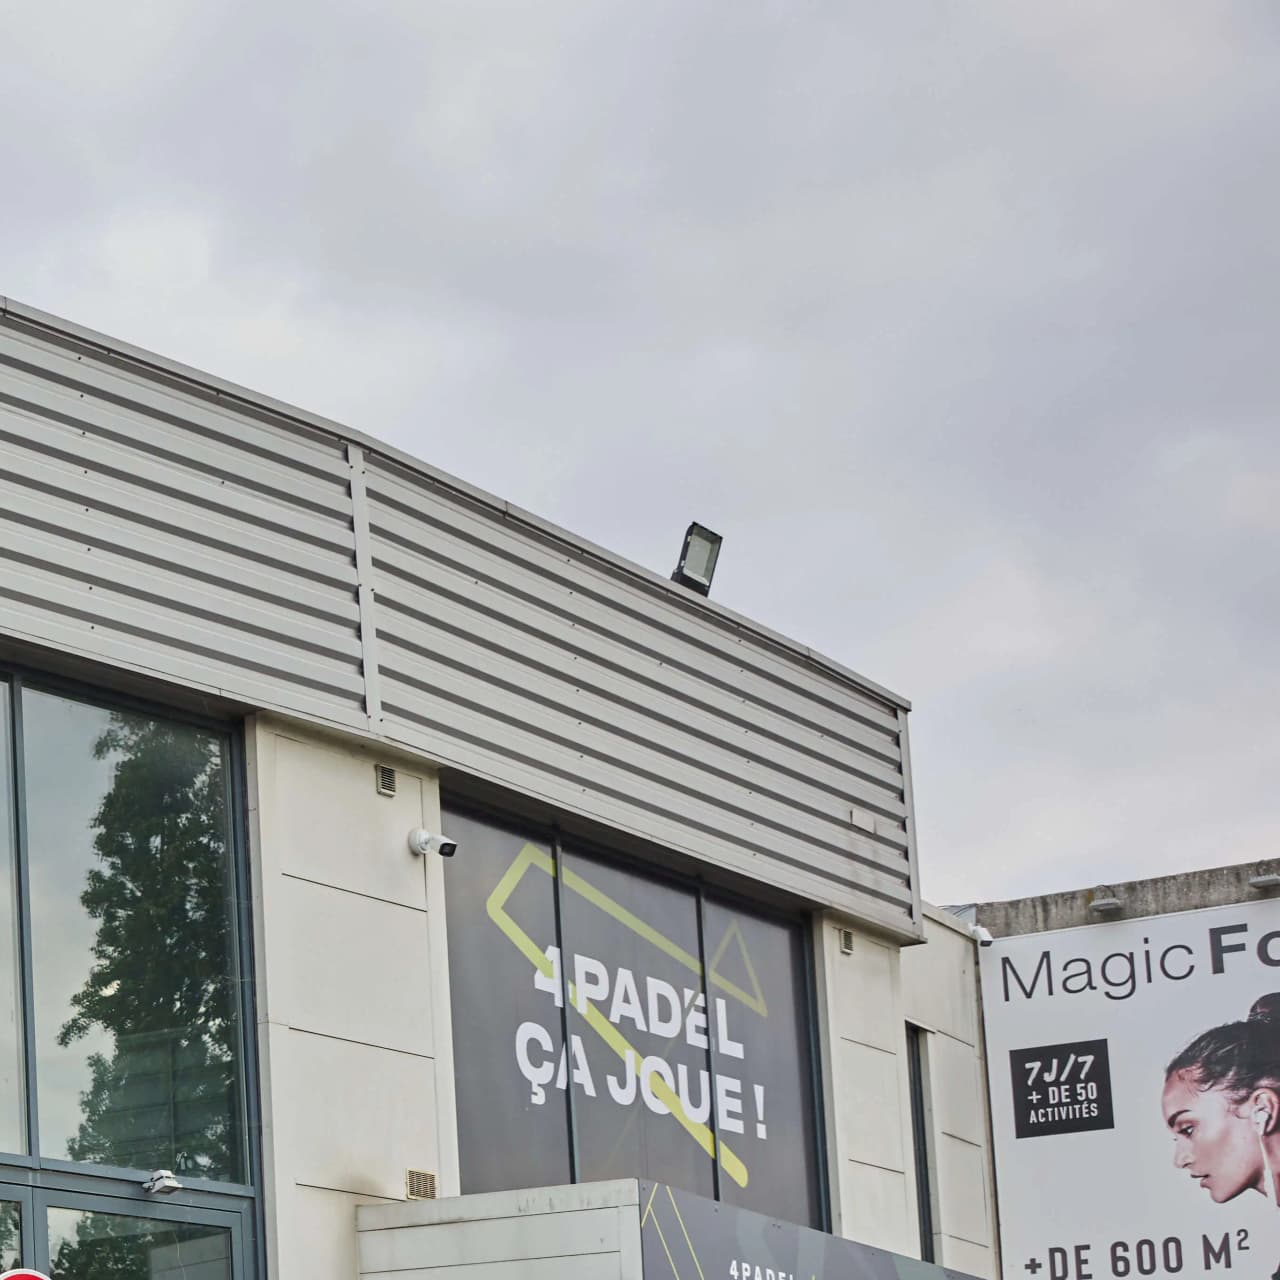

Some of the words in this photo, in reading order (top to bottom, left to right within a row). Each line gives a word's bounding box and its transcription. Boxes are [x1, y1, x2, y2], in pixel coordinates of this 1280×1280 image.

[515, 1021, 596, 1105] ÇA
[1024, 1054, 1095, 1087] 7J/7
[1048, 1085, 1071, 1105] DE
[1076, 1082, 1097, 1101] 50
[1029, 1102, 1098, 1125] ACTIVITÉS
[1110, 1236, 1183, 1278] 600
